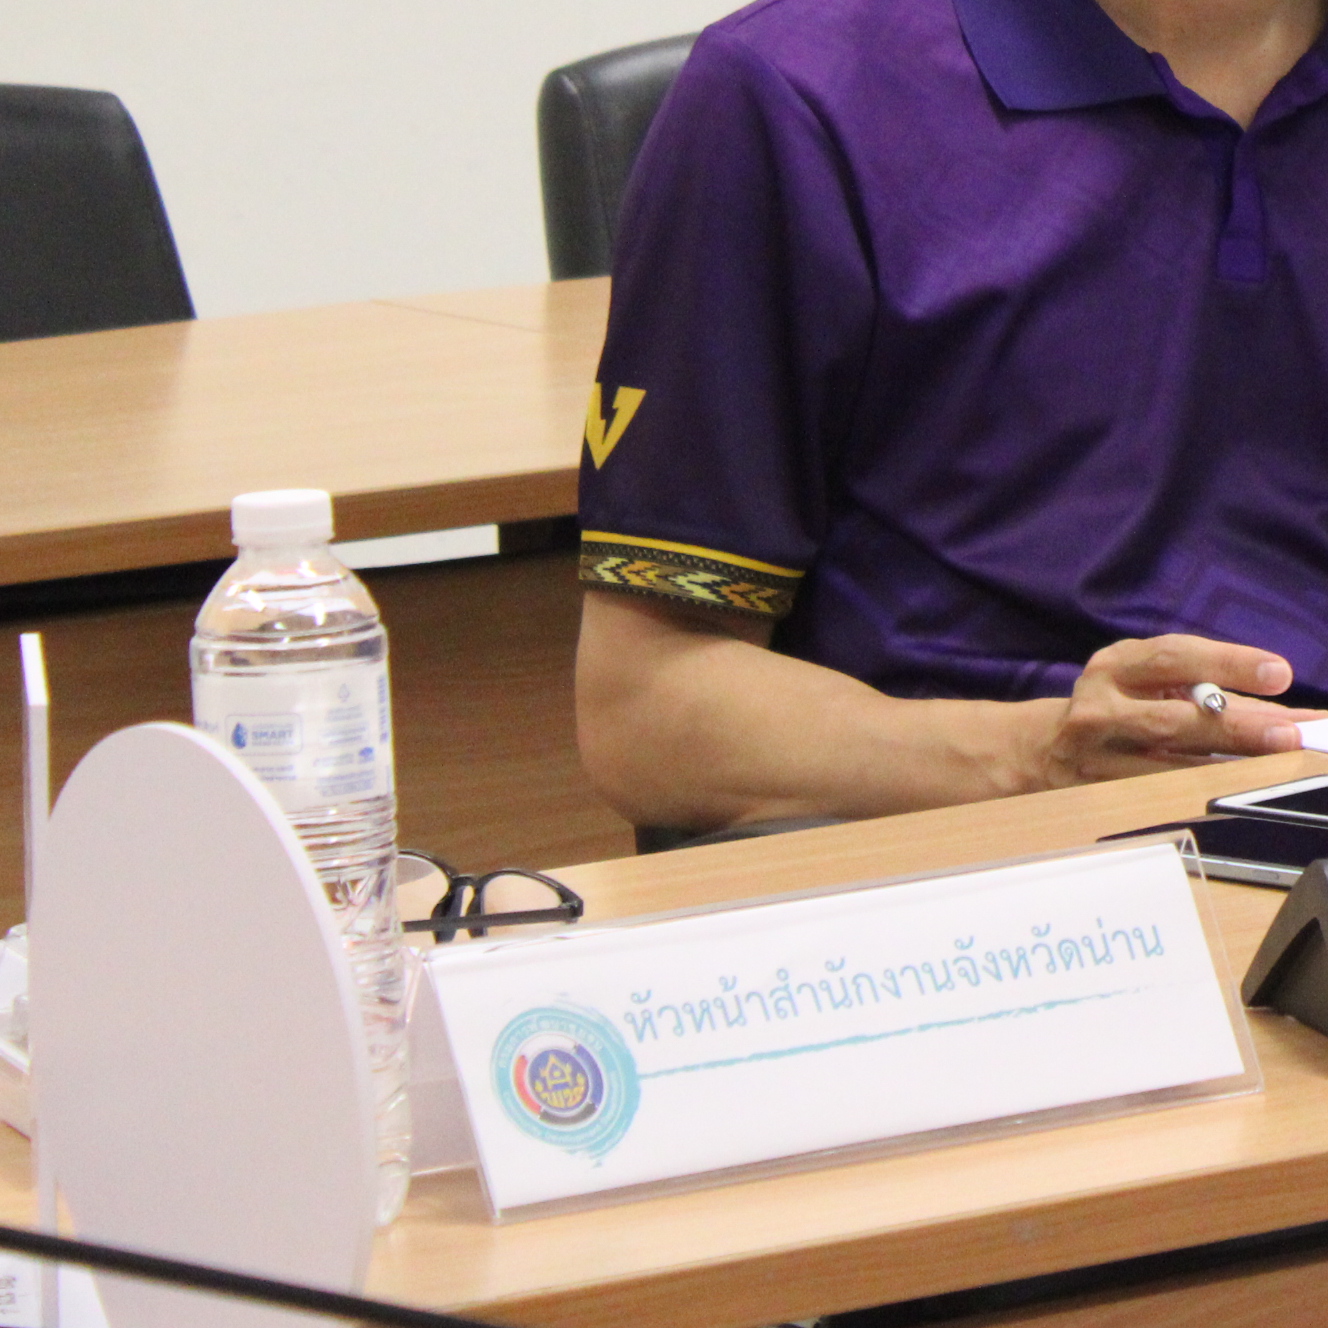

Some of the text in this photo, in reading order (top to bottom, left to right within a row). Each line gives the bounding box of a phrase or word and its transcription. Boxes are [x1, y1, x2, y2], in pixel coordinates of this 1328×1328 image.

[252, 729, 294, 740] SMART
[623, 918, 1164, 1044] หัวหน้าสำนักงานจังหวัดน่าน
